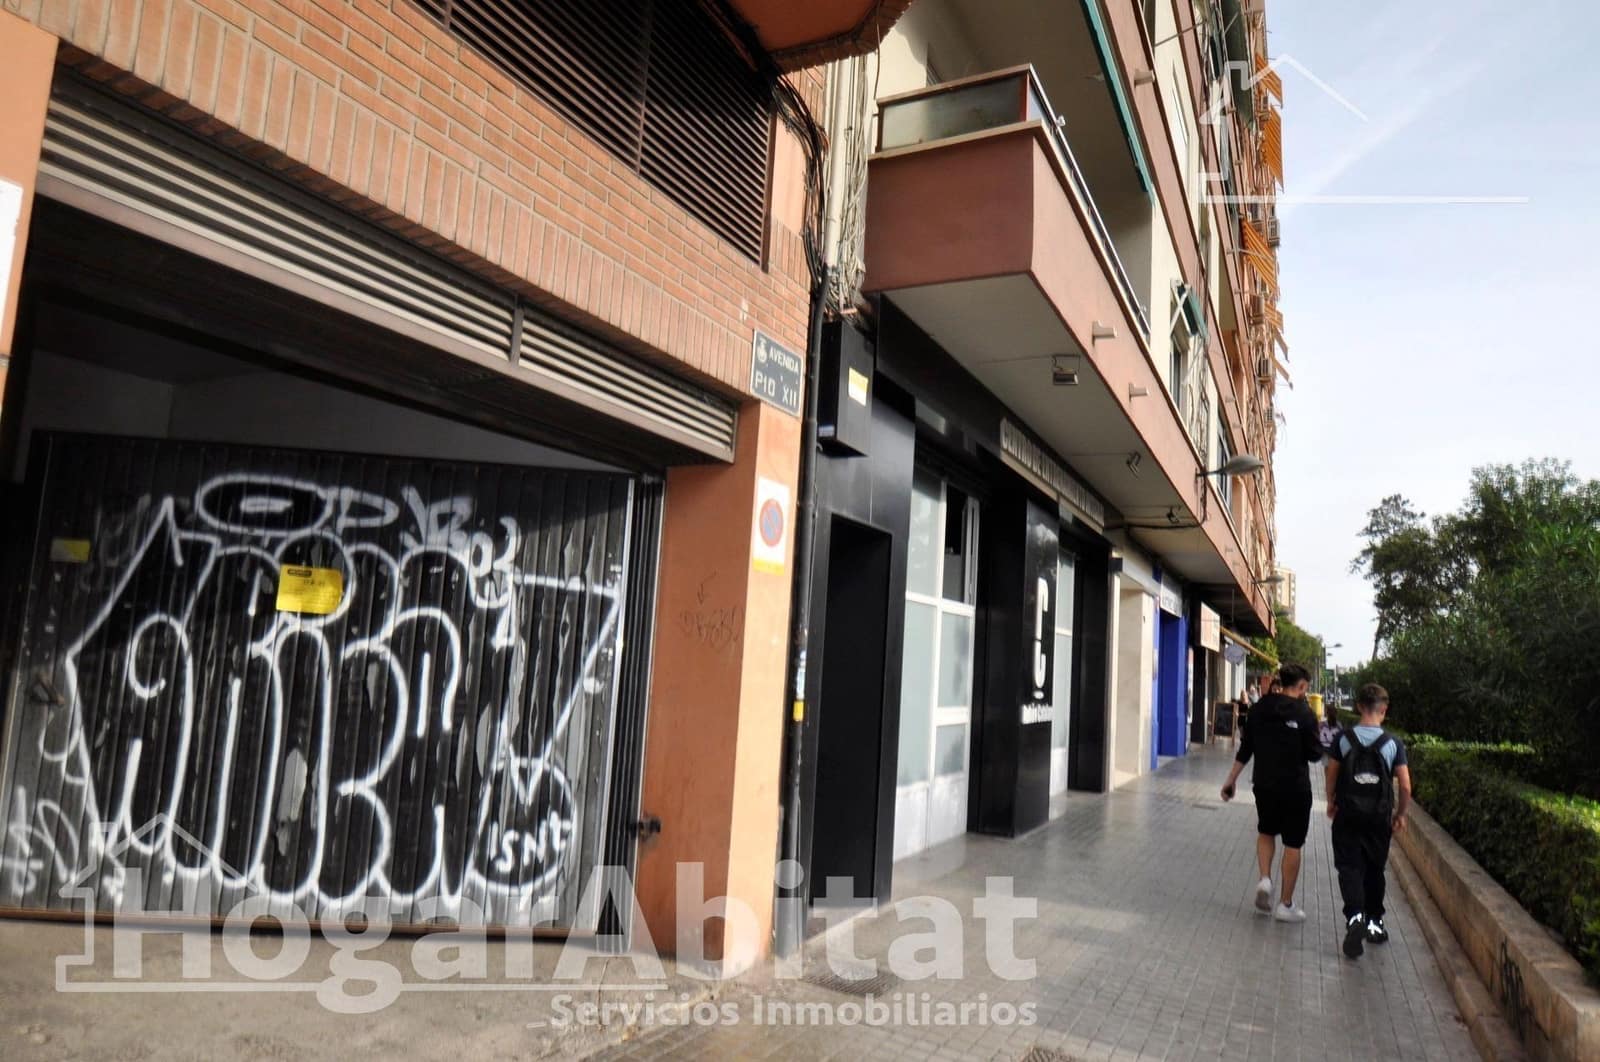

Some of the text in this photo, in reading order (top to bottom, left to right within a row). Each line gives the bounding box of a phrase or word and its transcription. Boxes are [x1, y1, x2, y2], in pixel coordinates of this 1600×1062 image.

[768, 346, 799, 376] AVENIDA
[755, 370, 797, 408] PIO XII
